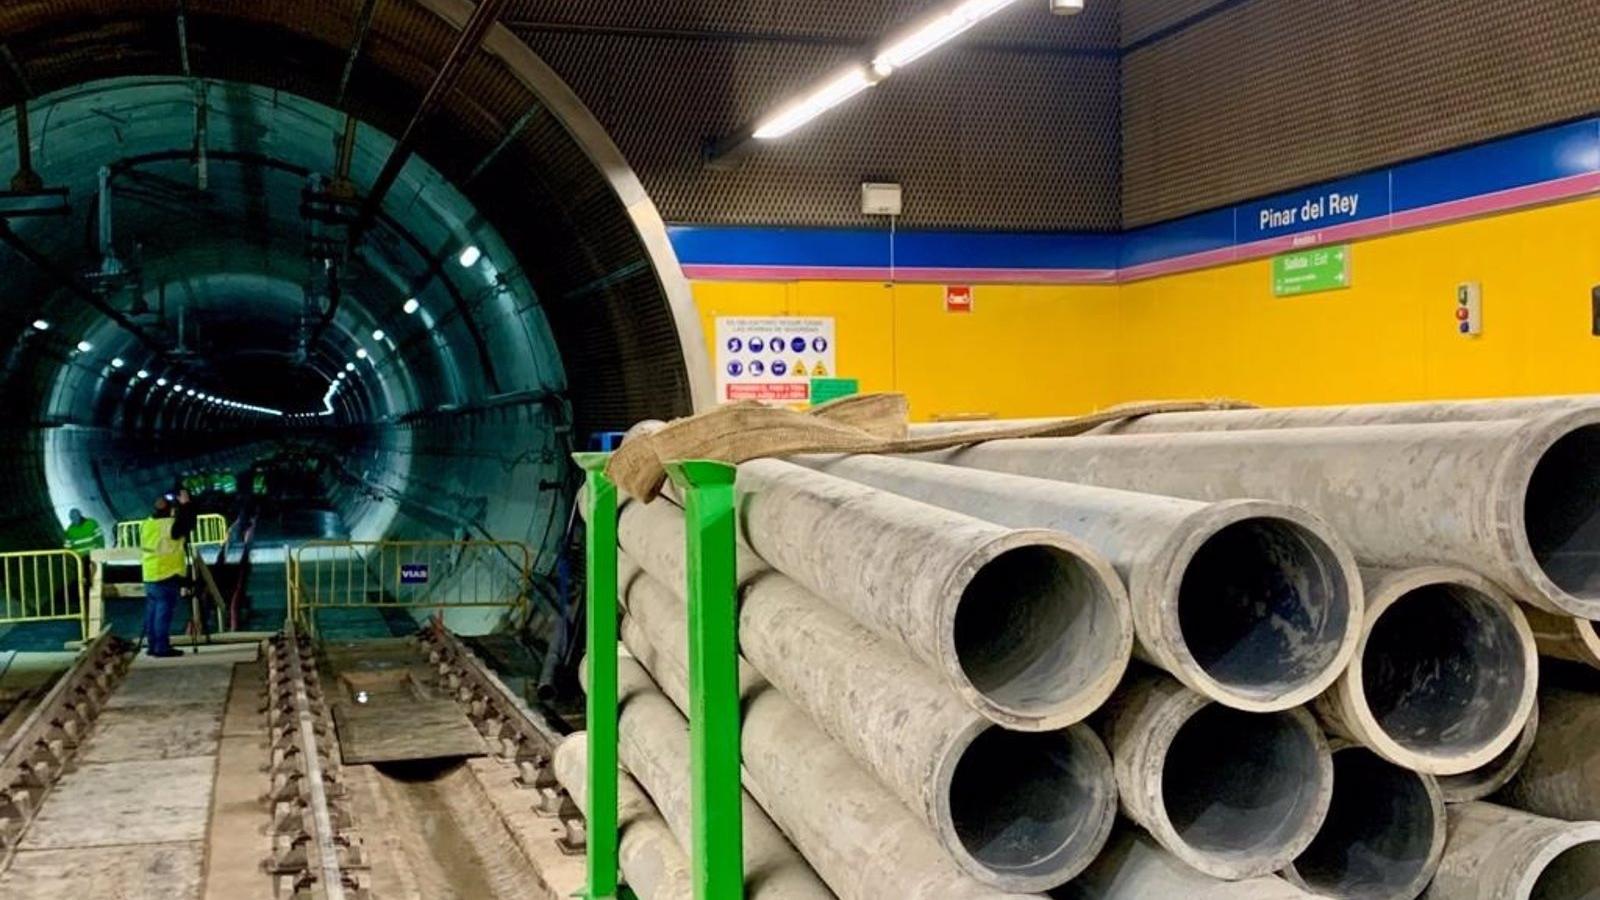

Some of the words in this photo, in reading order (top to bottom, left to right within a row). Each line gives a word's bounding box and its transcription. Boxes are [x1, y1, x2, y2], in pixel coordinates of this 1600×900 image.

[1260, 208, 1297, 230] Pinar
[1300, 196, 1324, 221] del
[1329, 193, 1359, 216] Rey
